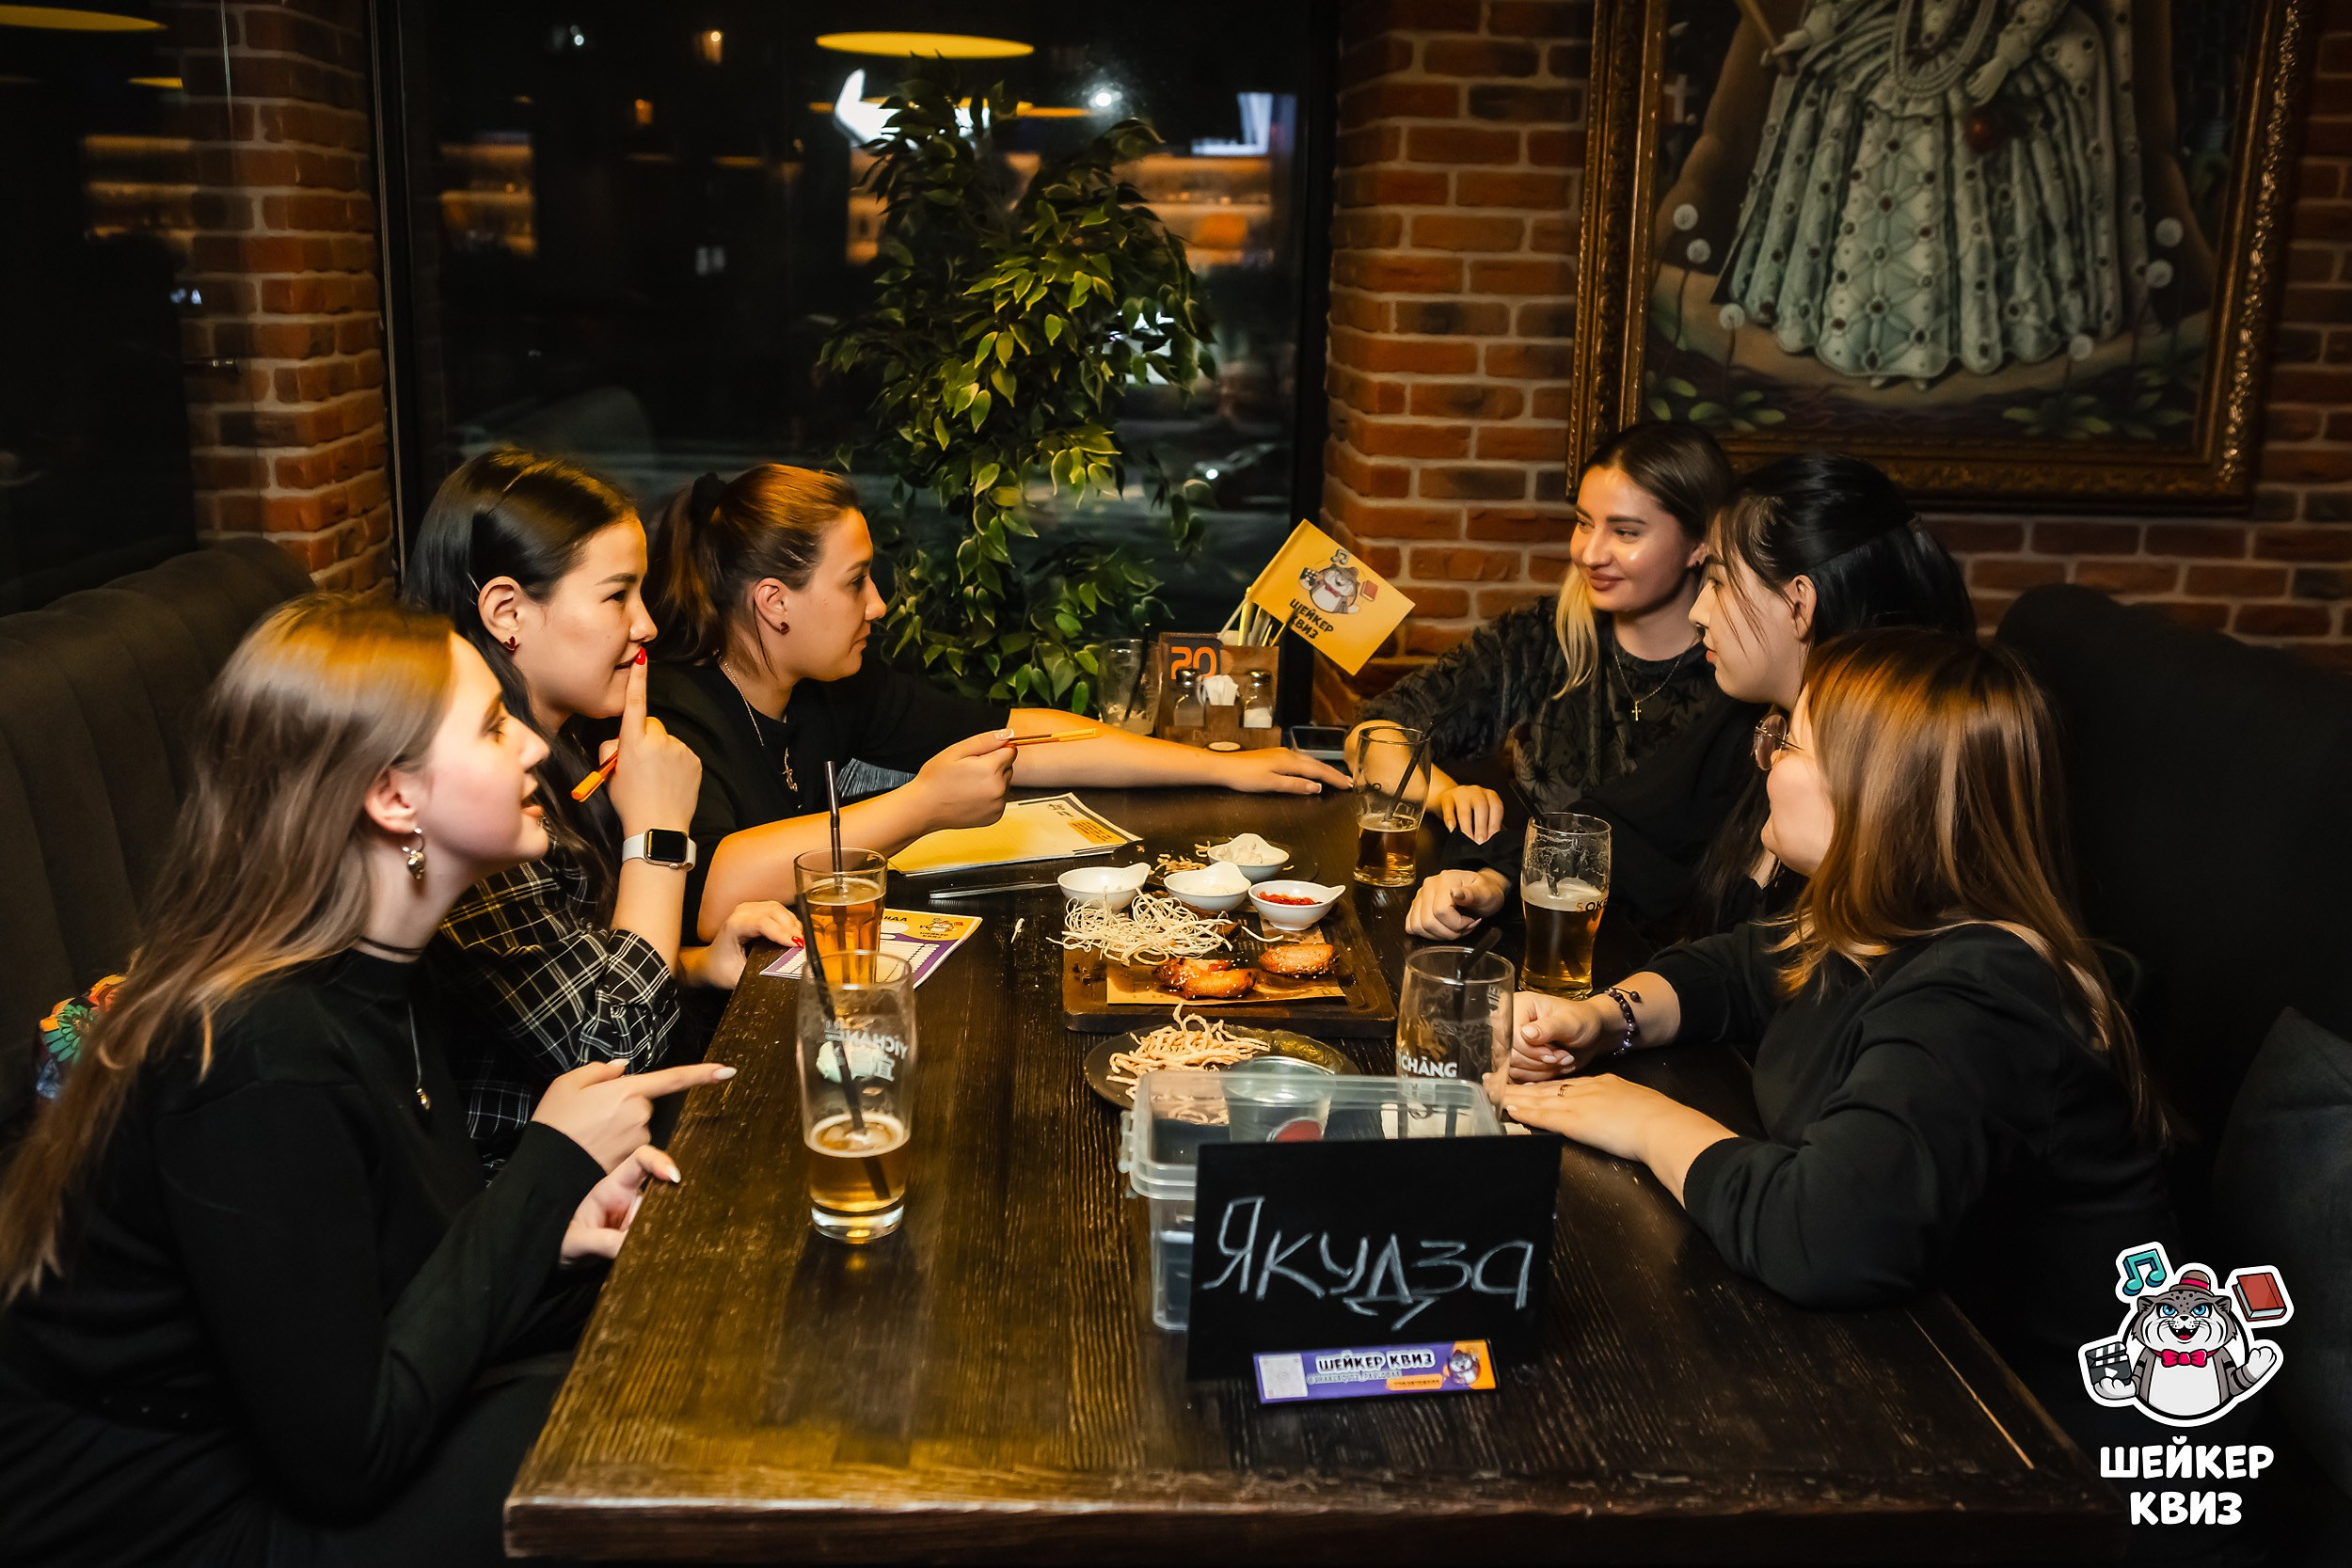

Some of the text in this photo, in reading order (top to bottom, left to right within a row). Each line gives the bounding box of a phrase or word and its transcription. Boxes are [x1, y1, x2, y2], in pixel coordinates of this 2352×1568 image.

[1289, 598, 1334, 632] ШЕЙКЕР
[1170, 646, 1217, 680] 20
[1317, 1352, 1434, 1371] ШЕЙКЕР КВИЗ
